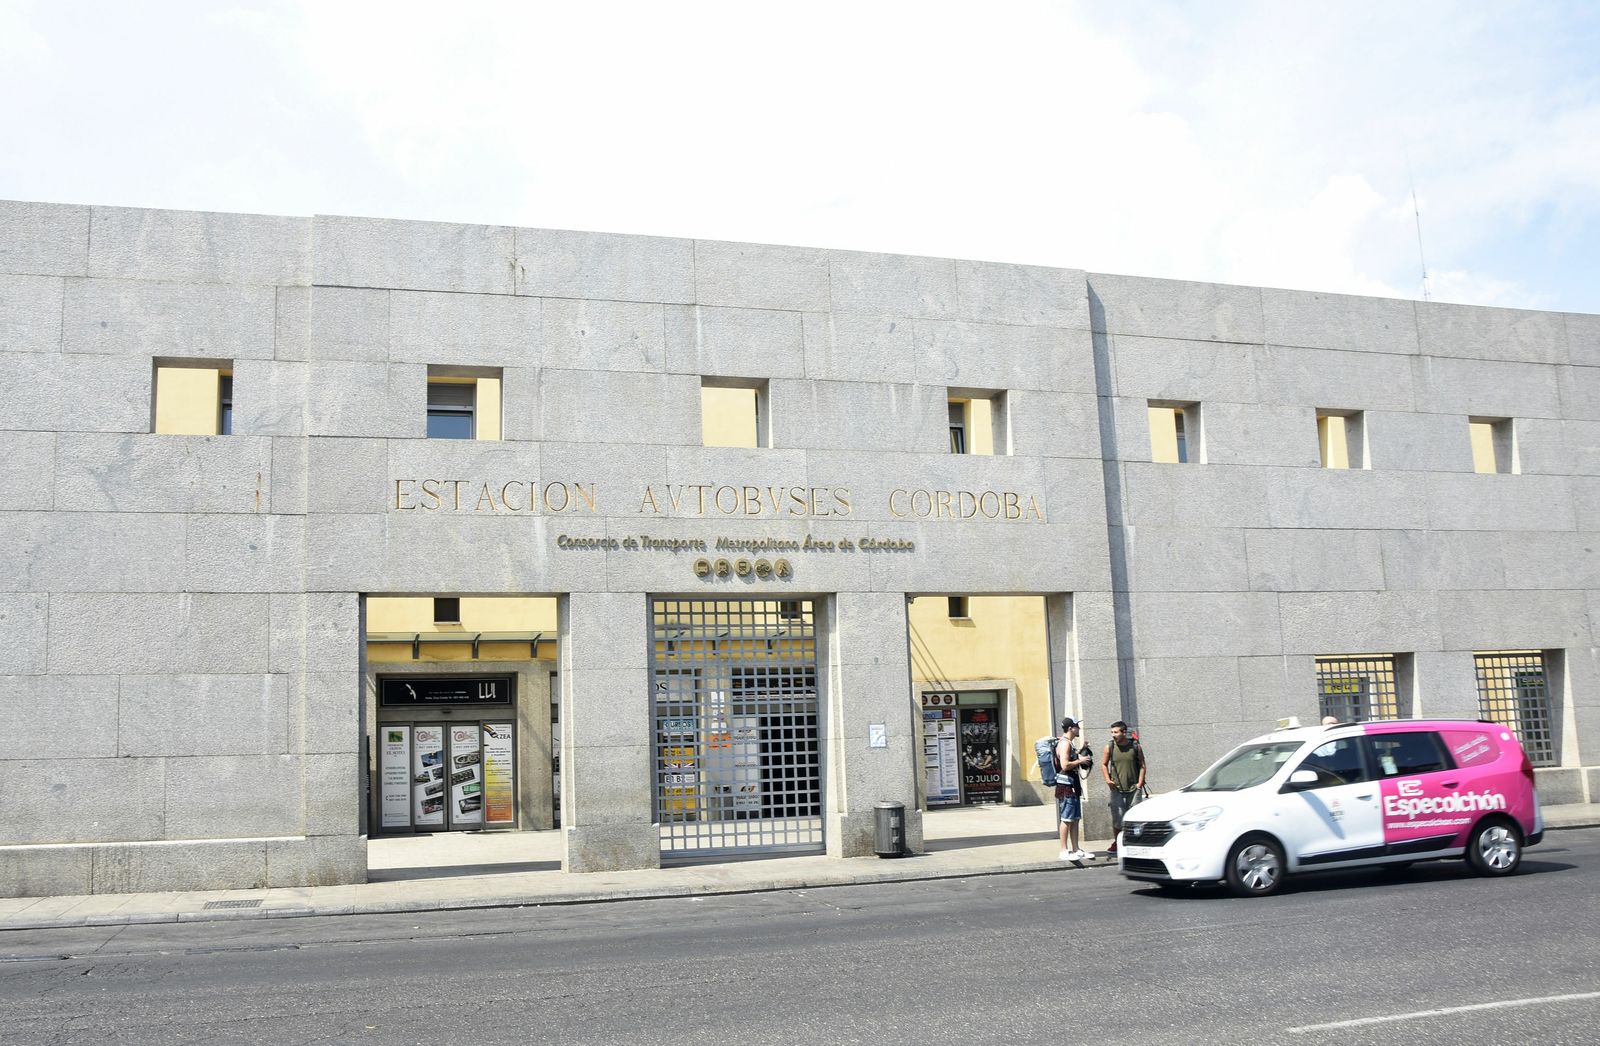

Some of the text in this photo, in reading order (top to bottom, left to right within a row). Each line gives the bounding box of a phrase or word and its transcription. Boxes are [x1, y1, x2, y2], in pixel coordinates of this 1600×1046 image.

[395, 479, 1043, 521] ESTACION AVTOBVSES CORDOBA
[557, 534, 915, 554] Consorcio de Transporte Metropolitano Área de Córdoba
[965, 774, 1001, 783] 12 JULIO
[1383, 789, 1507, 820] Especolchón
